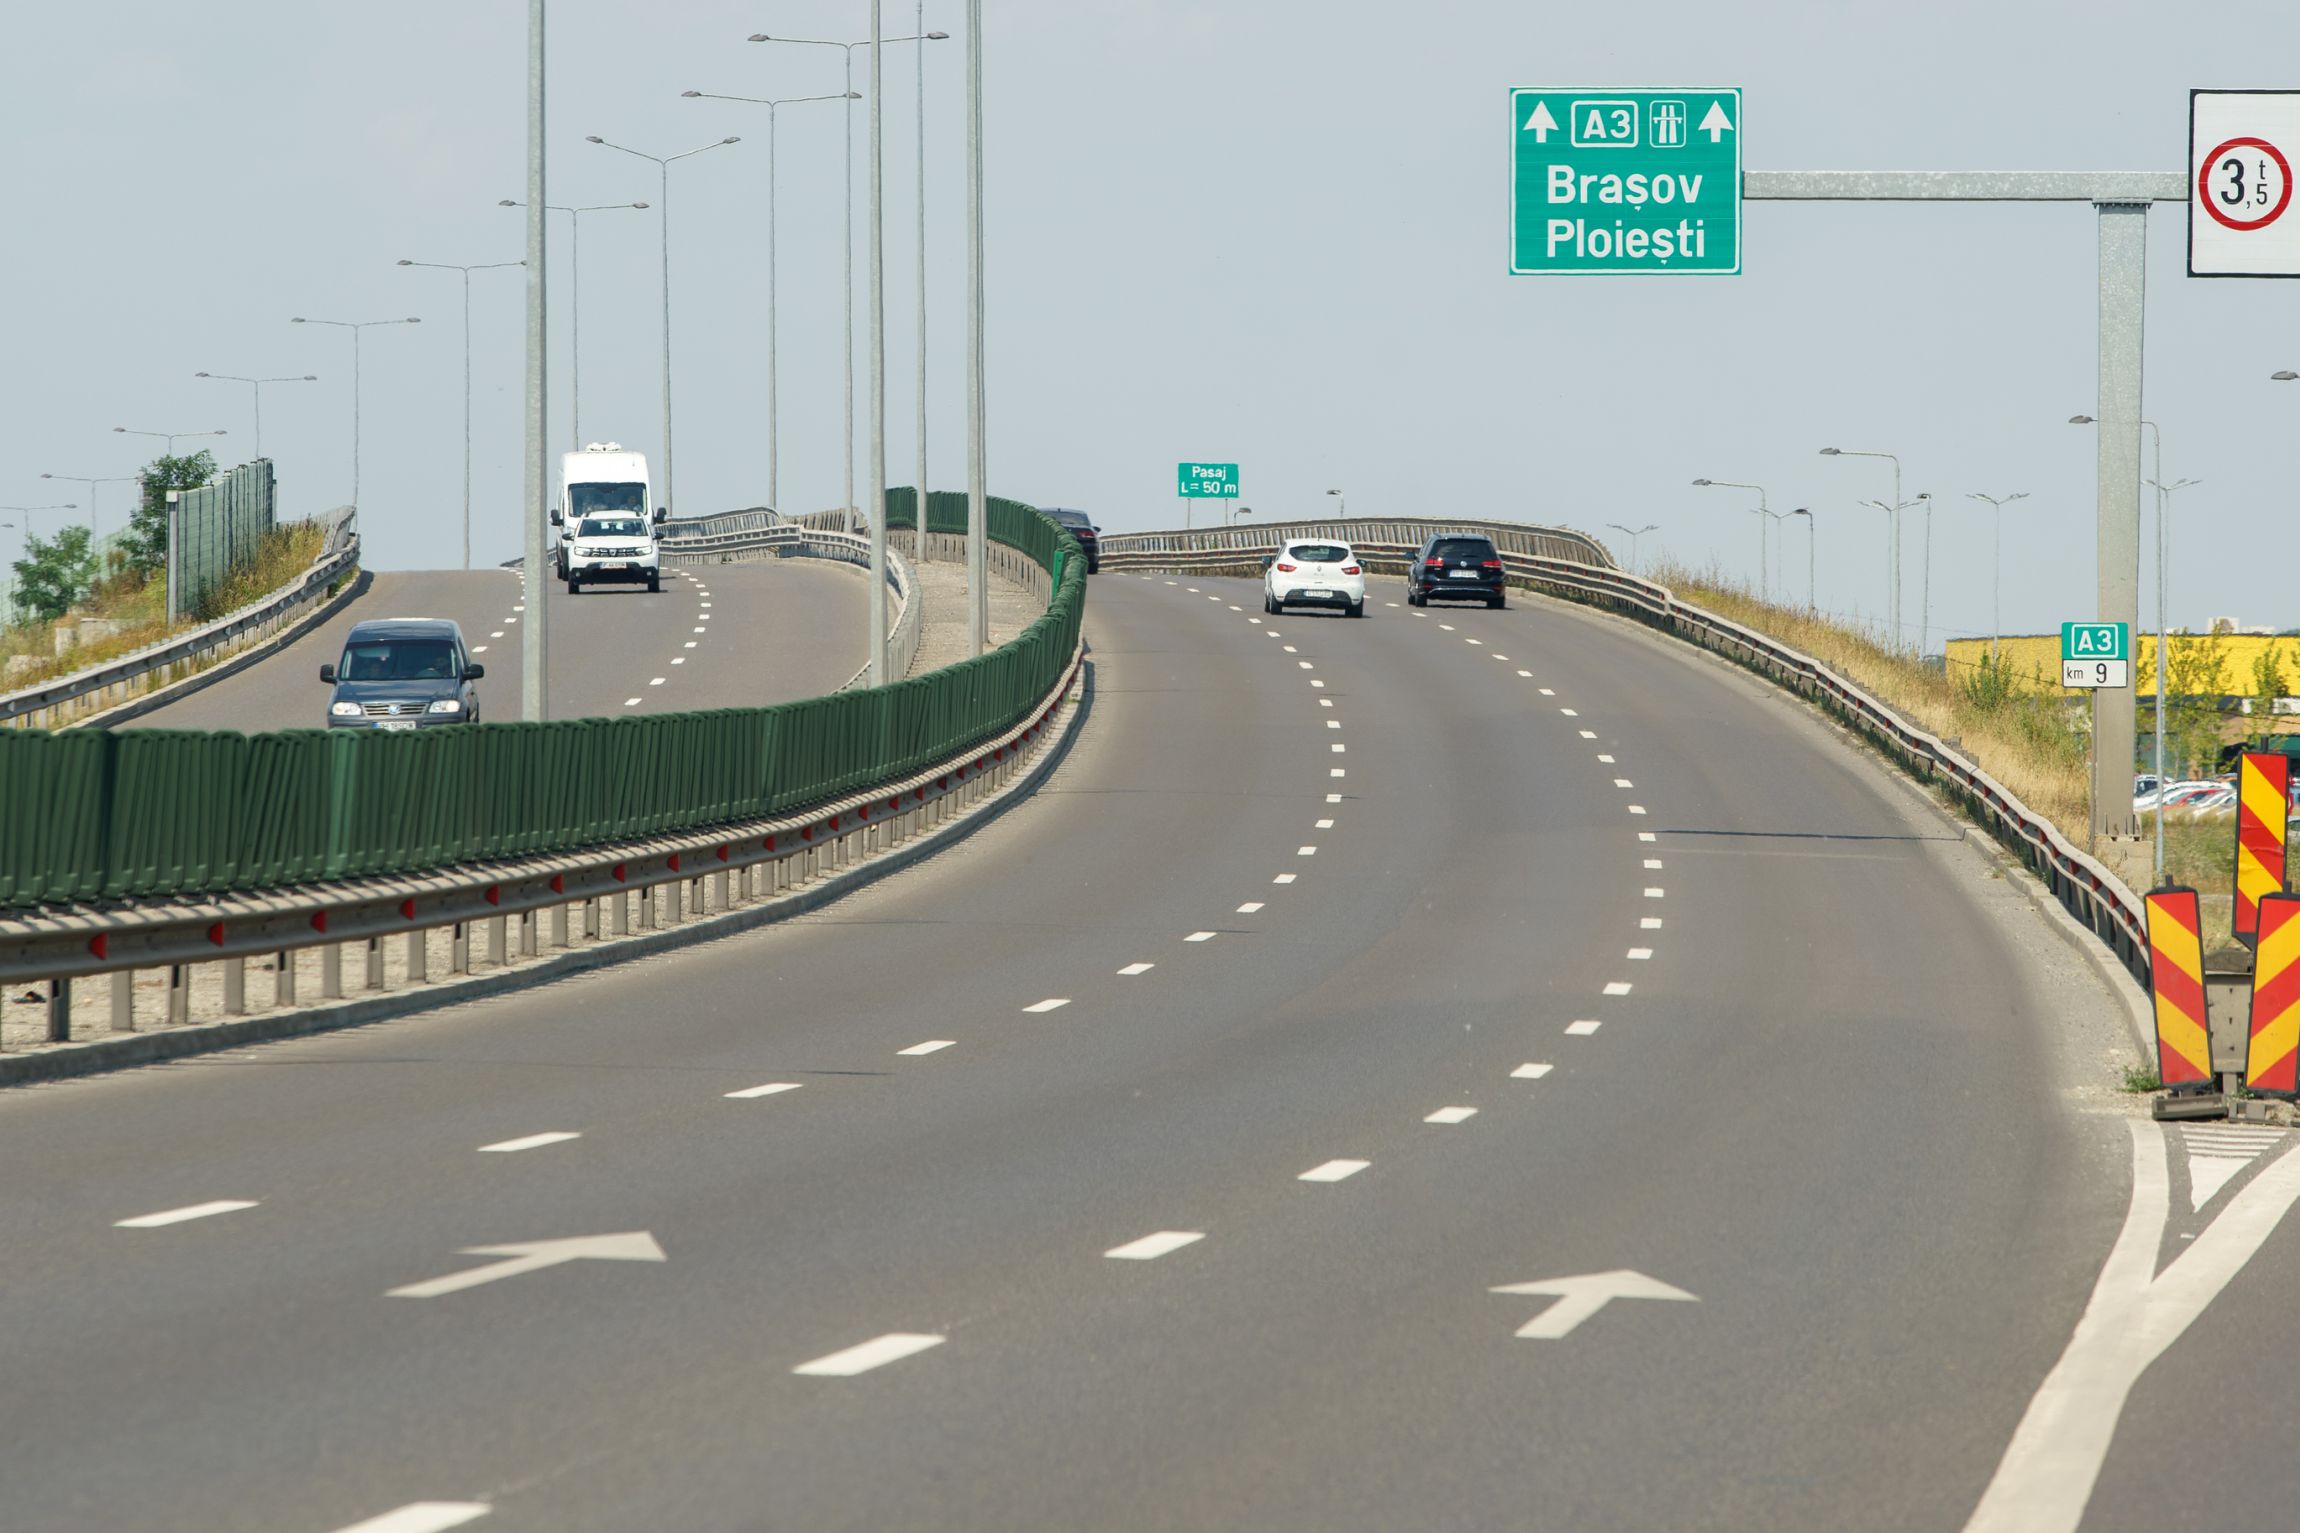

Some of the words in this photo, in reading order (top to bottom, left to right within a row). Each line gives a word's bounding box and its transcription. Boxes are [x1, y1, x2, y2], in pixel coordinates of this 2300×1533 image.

[1583, 109, 1631, 139] A3
[1547, 165, 1703, 211] Brașov
[1547, 218, 1704, 265] Ploiești
[1192, 465, 1226, 481] Pasaj
[1203, 481, 1220, 494] 50
[1224, 483, 1237, 494] m
[2077, 629, 2112, 652] A3
[2066, 666, 2084, 680] km
[2096, 662, 2107, 684] 9
